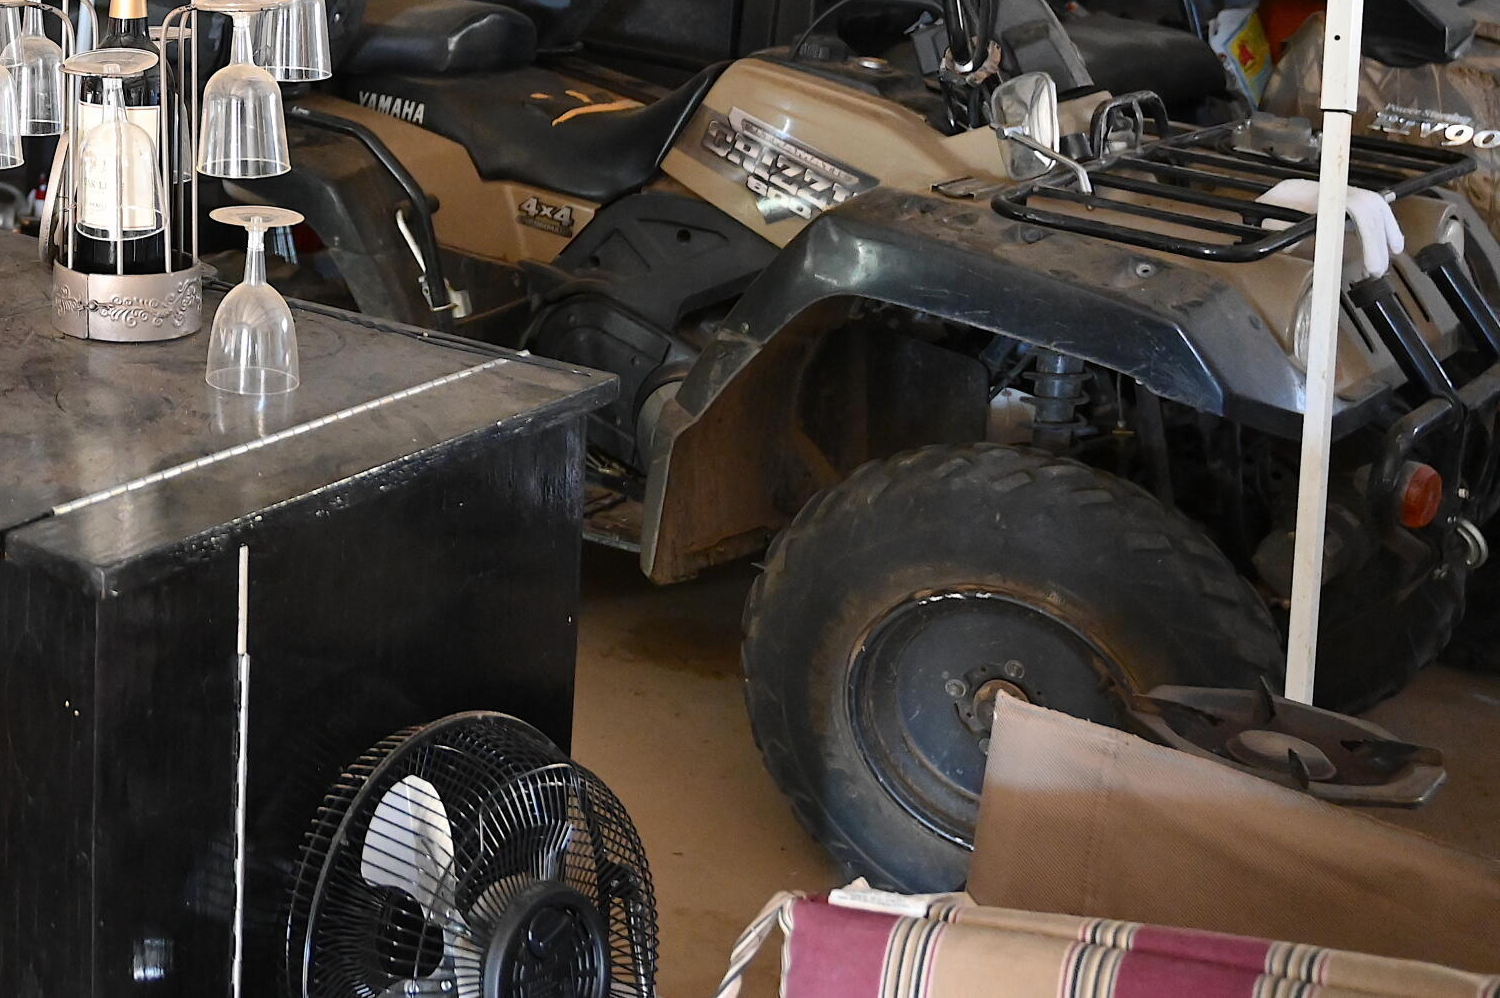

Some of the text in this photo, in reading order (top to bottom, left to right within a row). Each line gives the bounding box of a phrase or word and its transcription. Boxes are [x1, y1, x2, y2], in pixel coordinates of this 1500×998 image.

[358, 90, 425, 125] YAMAHA
[703, 120, 859, 213] GRIZZL
[519, 196, 574, 226] 4x4
